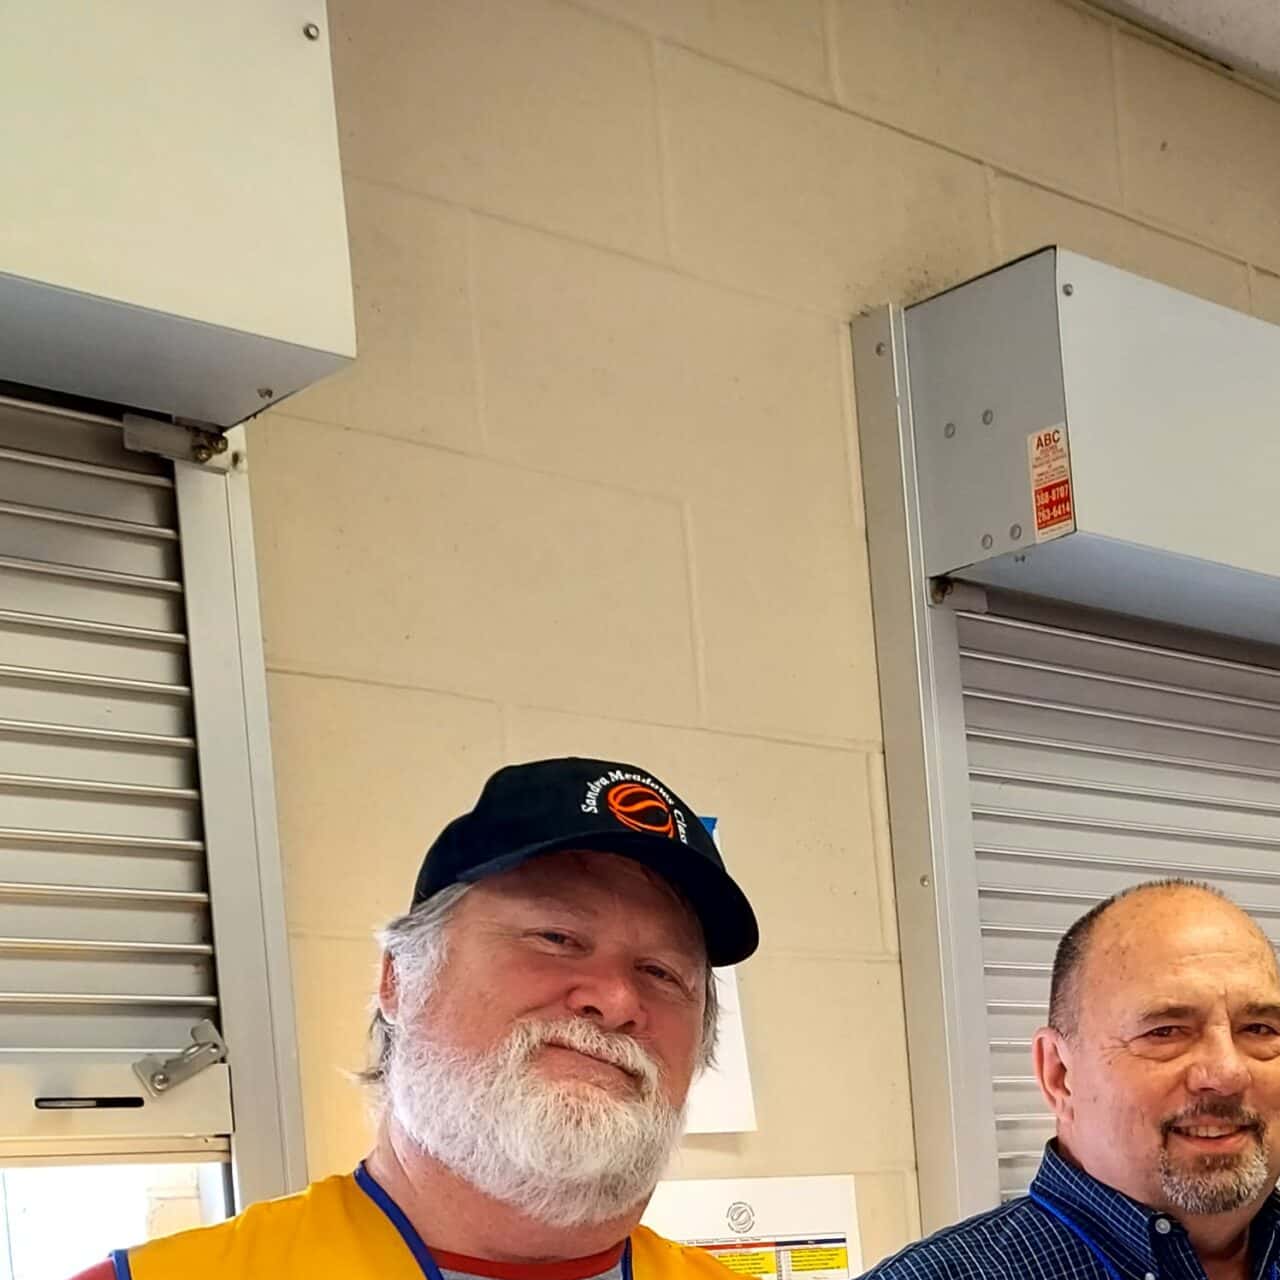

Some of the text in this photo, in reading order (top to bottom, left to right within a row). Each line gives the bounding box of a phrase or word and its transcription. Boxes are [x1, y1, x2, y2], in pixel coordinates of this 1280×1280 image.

[1036, 430, 1060, 450] ABC
[581, 776, 611, 814] Sandra
[608, 770, 675, 805] Meadows
